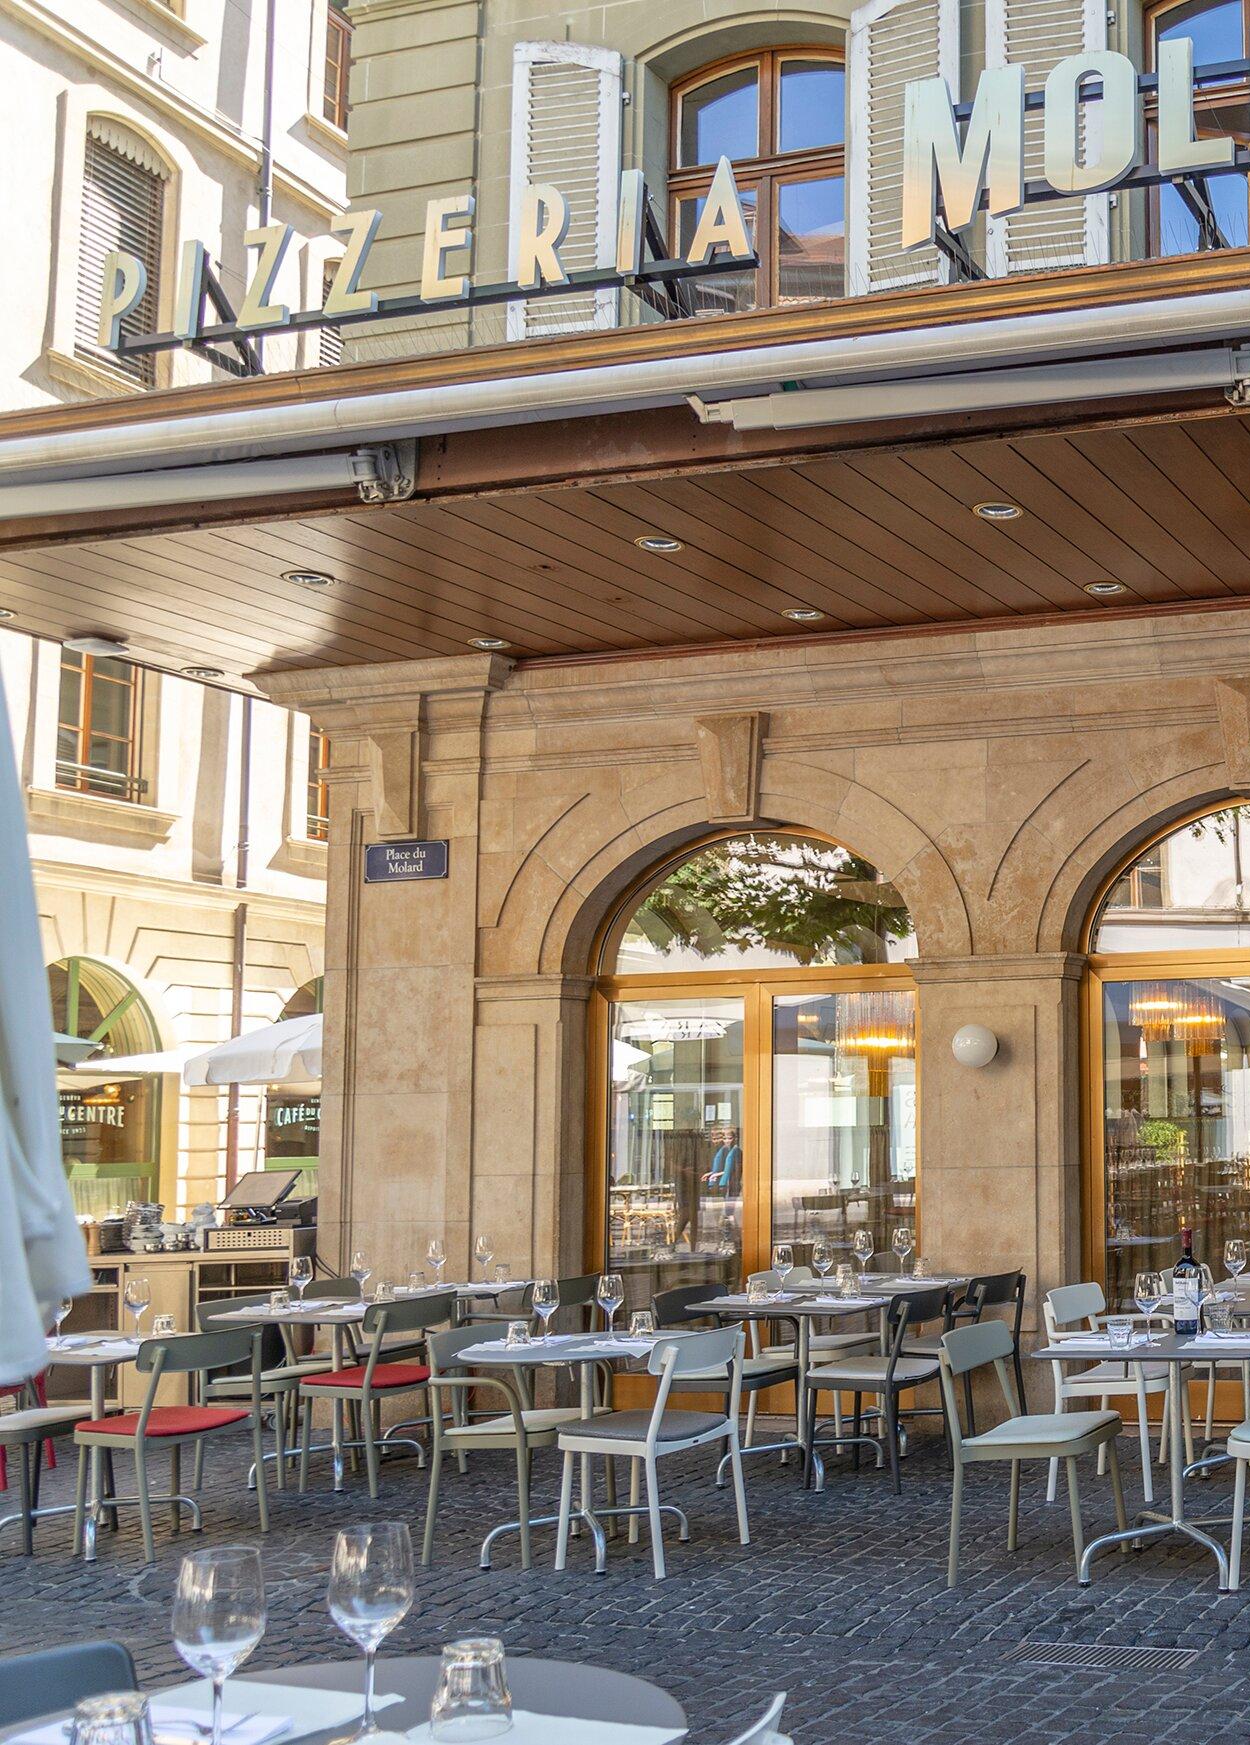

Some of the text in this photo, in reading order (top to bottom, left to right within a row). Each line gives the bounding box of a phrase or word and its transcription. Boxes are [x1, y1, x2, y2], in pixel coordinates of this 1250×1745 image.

[98, 155, 755, 350] PIZZERIA
[386, 847, 426, 861] Place du
[388, 860, 423, 874] Molard
[67, 1105, 125, 1128] CENTRE
[277, 1103, 305, 1127] CAFÉ
[305, 1107, 315, 1116] DU
